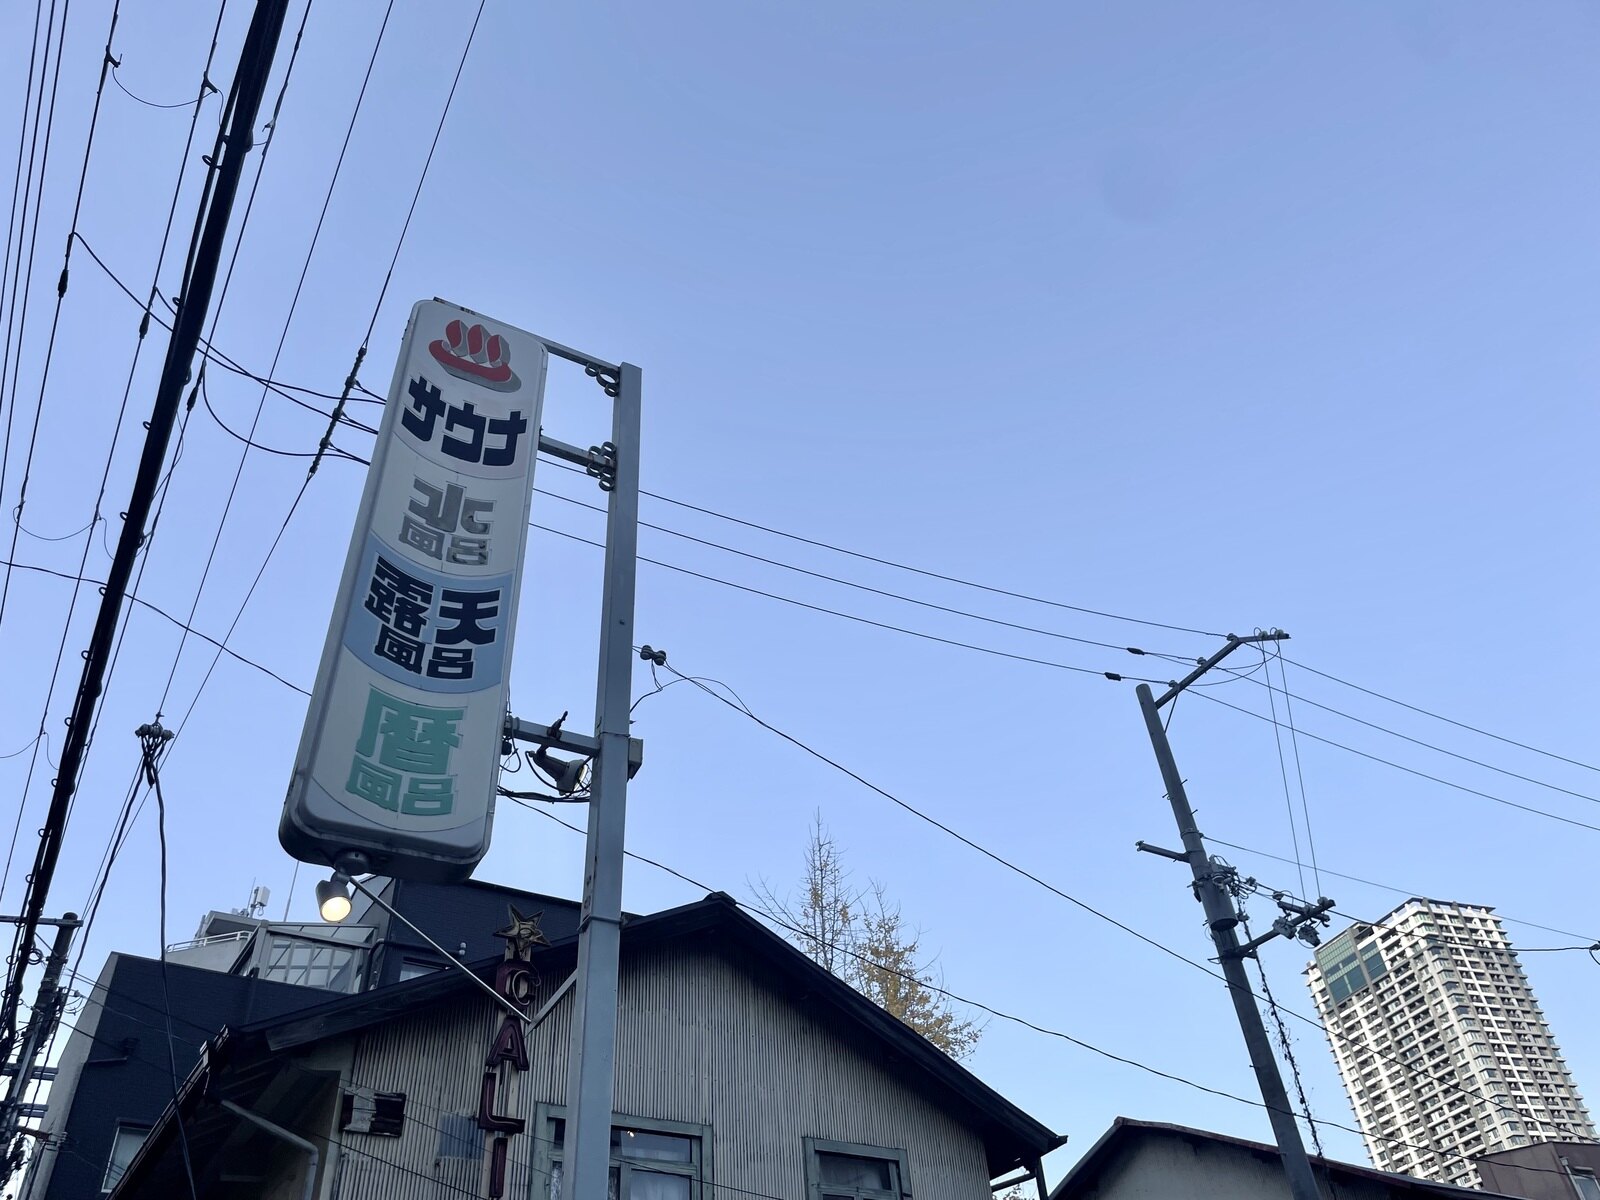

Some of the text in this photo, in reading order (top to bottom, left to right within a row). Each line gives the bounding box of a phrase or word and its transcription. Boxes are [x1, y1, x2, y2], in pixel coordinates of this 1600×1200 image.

[401, 375, 527, 467] サウナ
[398, 514, 488, 566] 風呂
[364, 555, 501, 646] 露天
[374, 623, 474, 680] 風呂
[345, 753, 454, 816] 風呂
